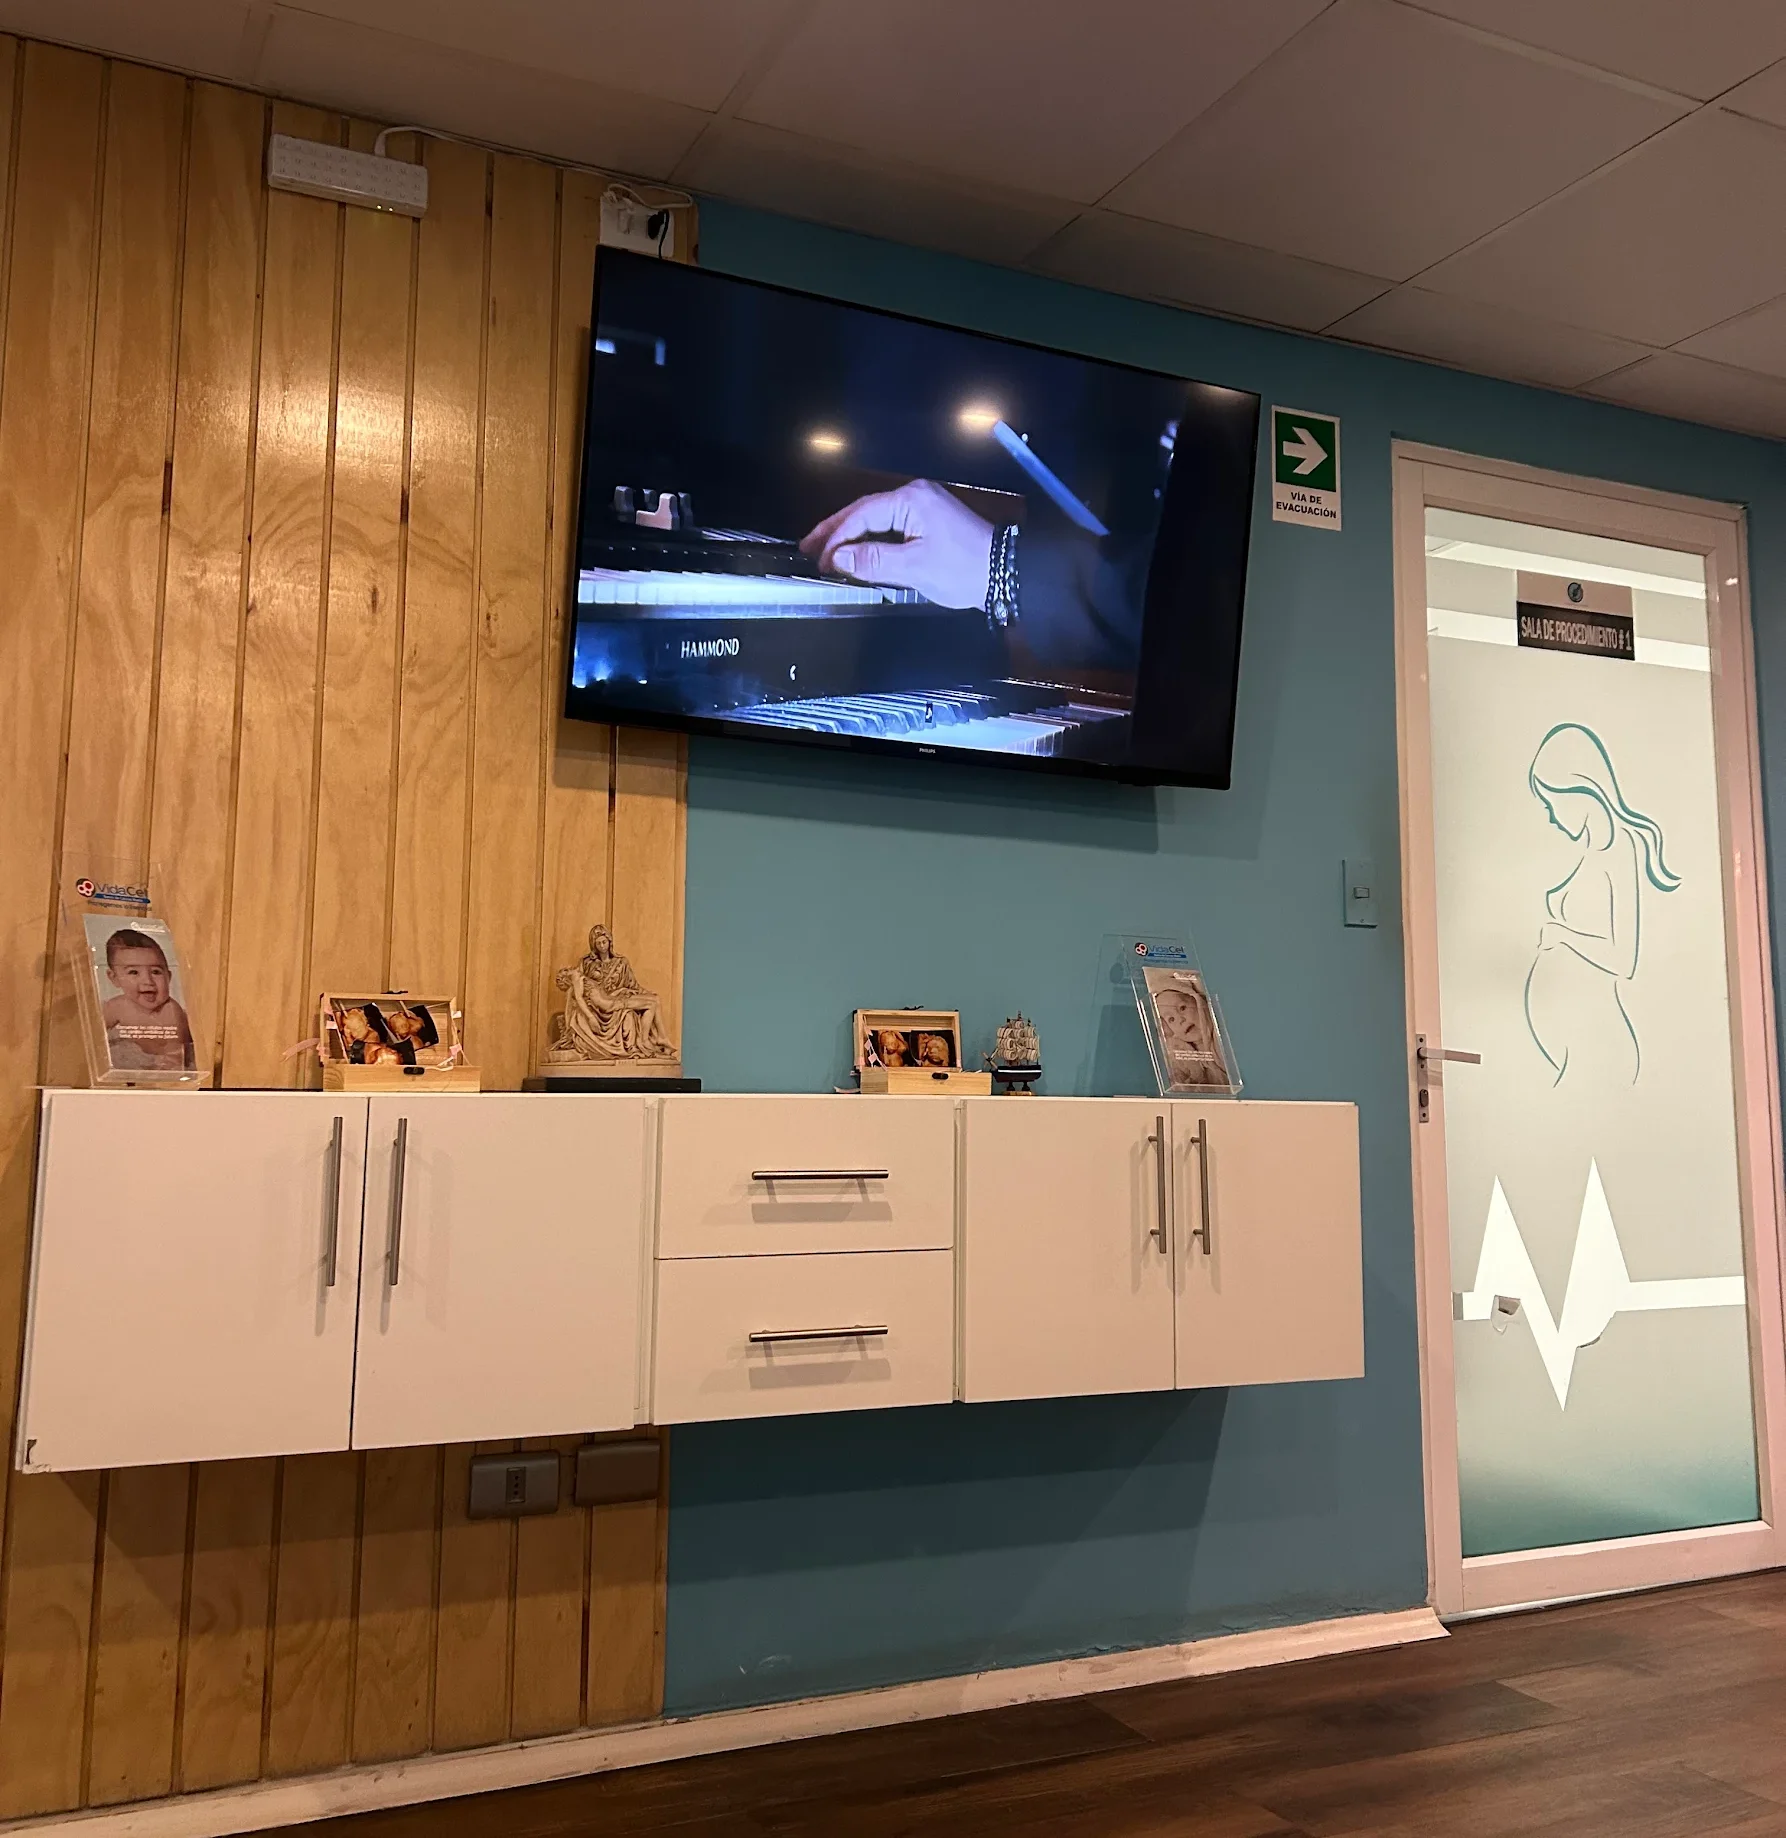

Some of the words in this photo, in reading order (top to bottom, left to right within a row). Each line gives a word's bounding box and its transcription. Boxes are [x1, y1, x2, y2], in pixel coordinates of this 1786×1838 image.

[1290, 491, 1307, 503] VÍA
[1309, 495, 1323, 505] DE
[1275, 501, 1337, 518] EVACUACIÓN
[1521, 615, 1543, 640] SALA
[1543, 618, 1556, 641] DE
[1556, 620, 1618, 650] PROCEDIMIENTO
[1619, 629, 1625, 650] #
[1625, 629, 1632, 651] 1
[681, 638, 740, 659] HAMMOND
[96, 882, 149, 898] VidaCel
